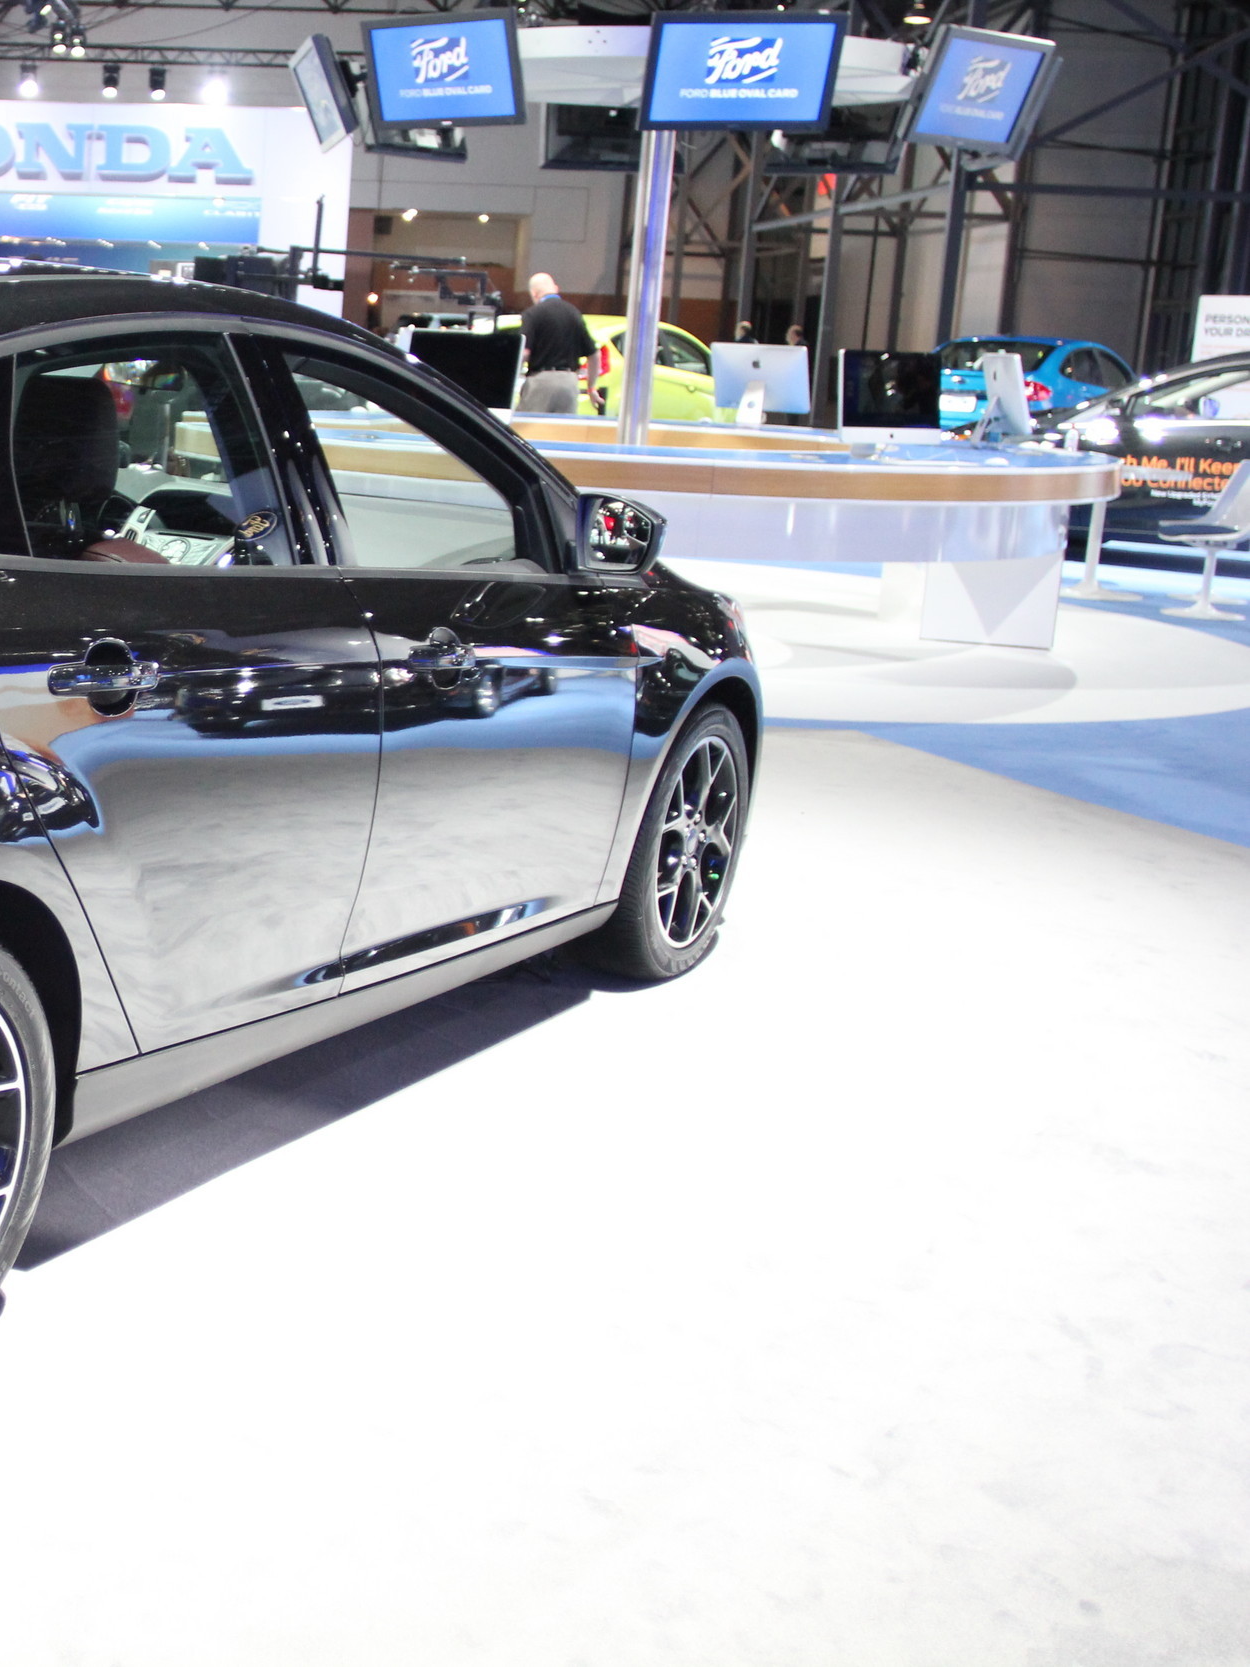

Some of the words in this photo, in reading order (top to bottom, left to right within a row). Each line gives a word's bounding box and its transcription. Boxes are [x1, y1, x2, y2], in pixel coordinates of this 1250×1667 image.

[411, 37, 469, 83] Ford
[704, 36, 783, 84] Ford
[709, 88, 737, 98] BLUE
[737, 88, 766, 98] OVAL
[767, 88, 799, 98] CARD
